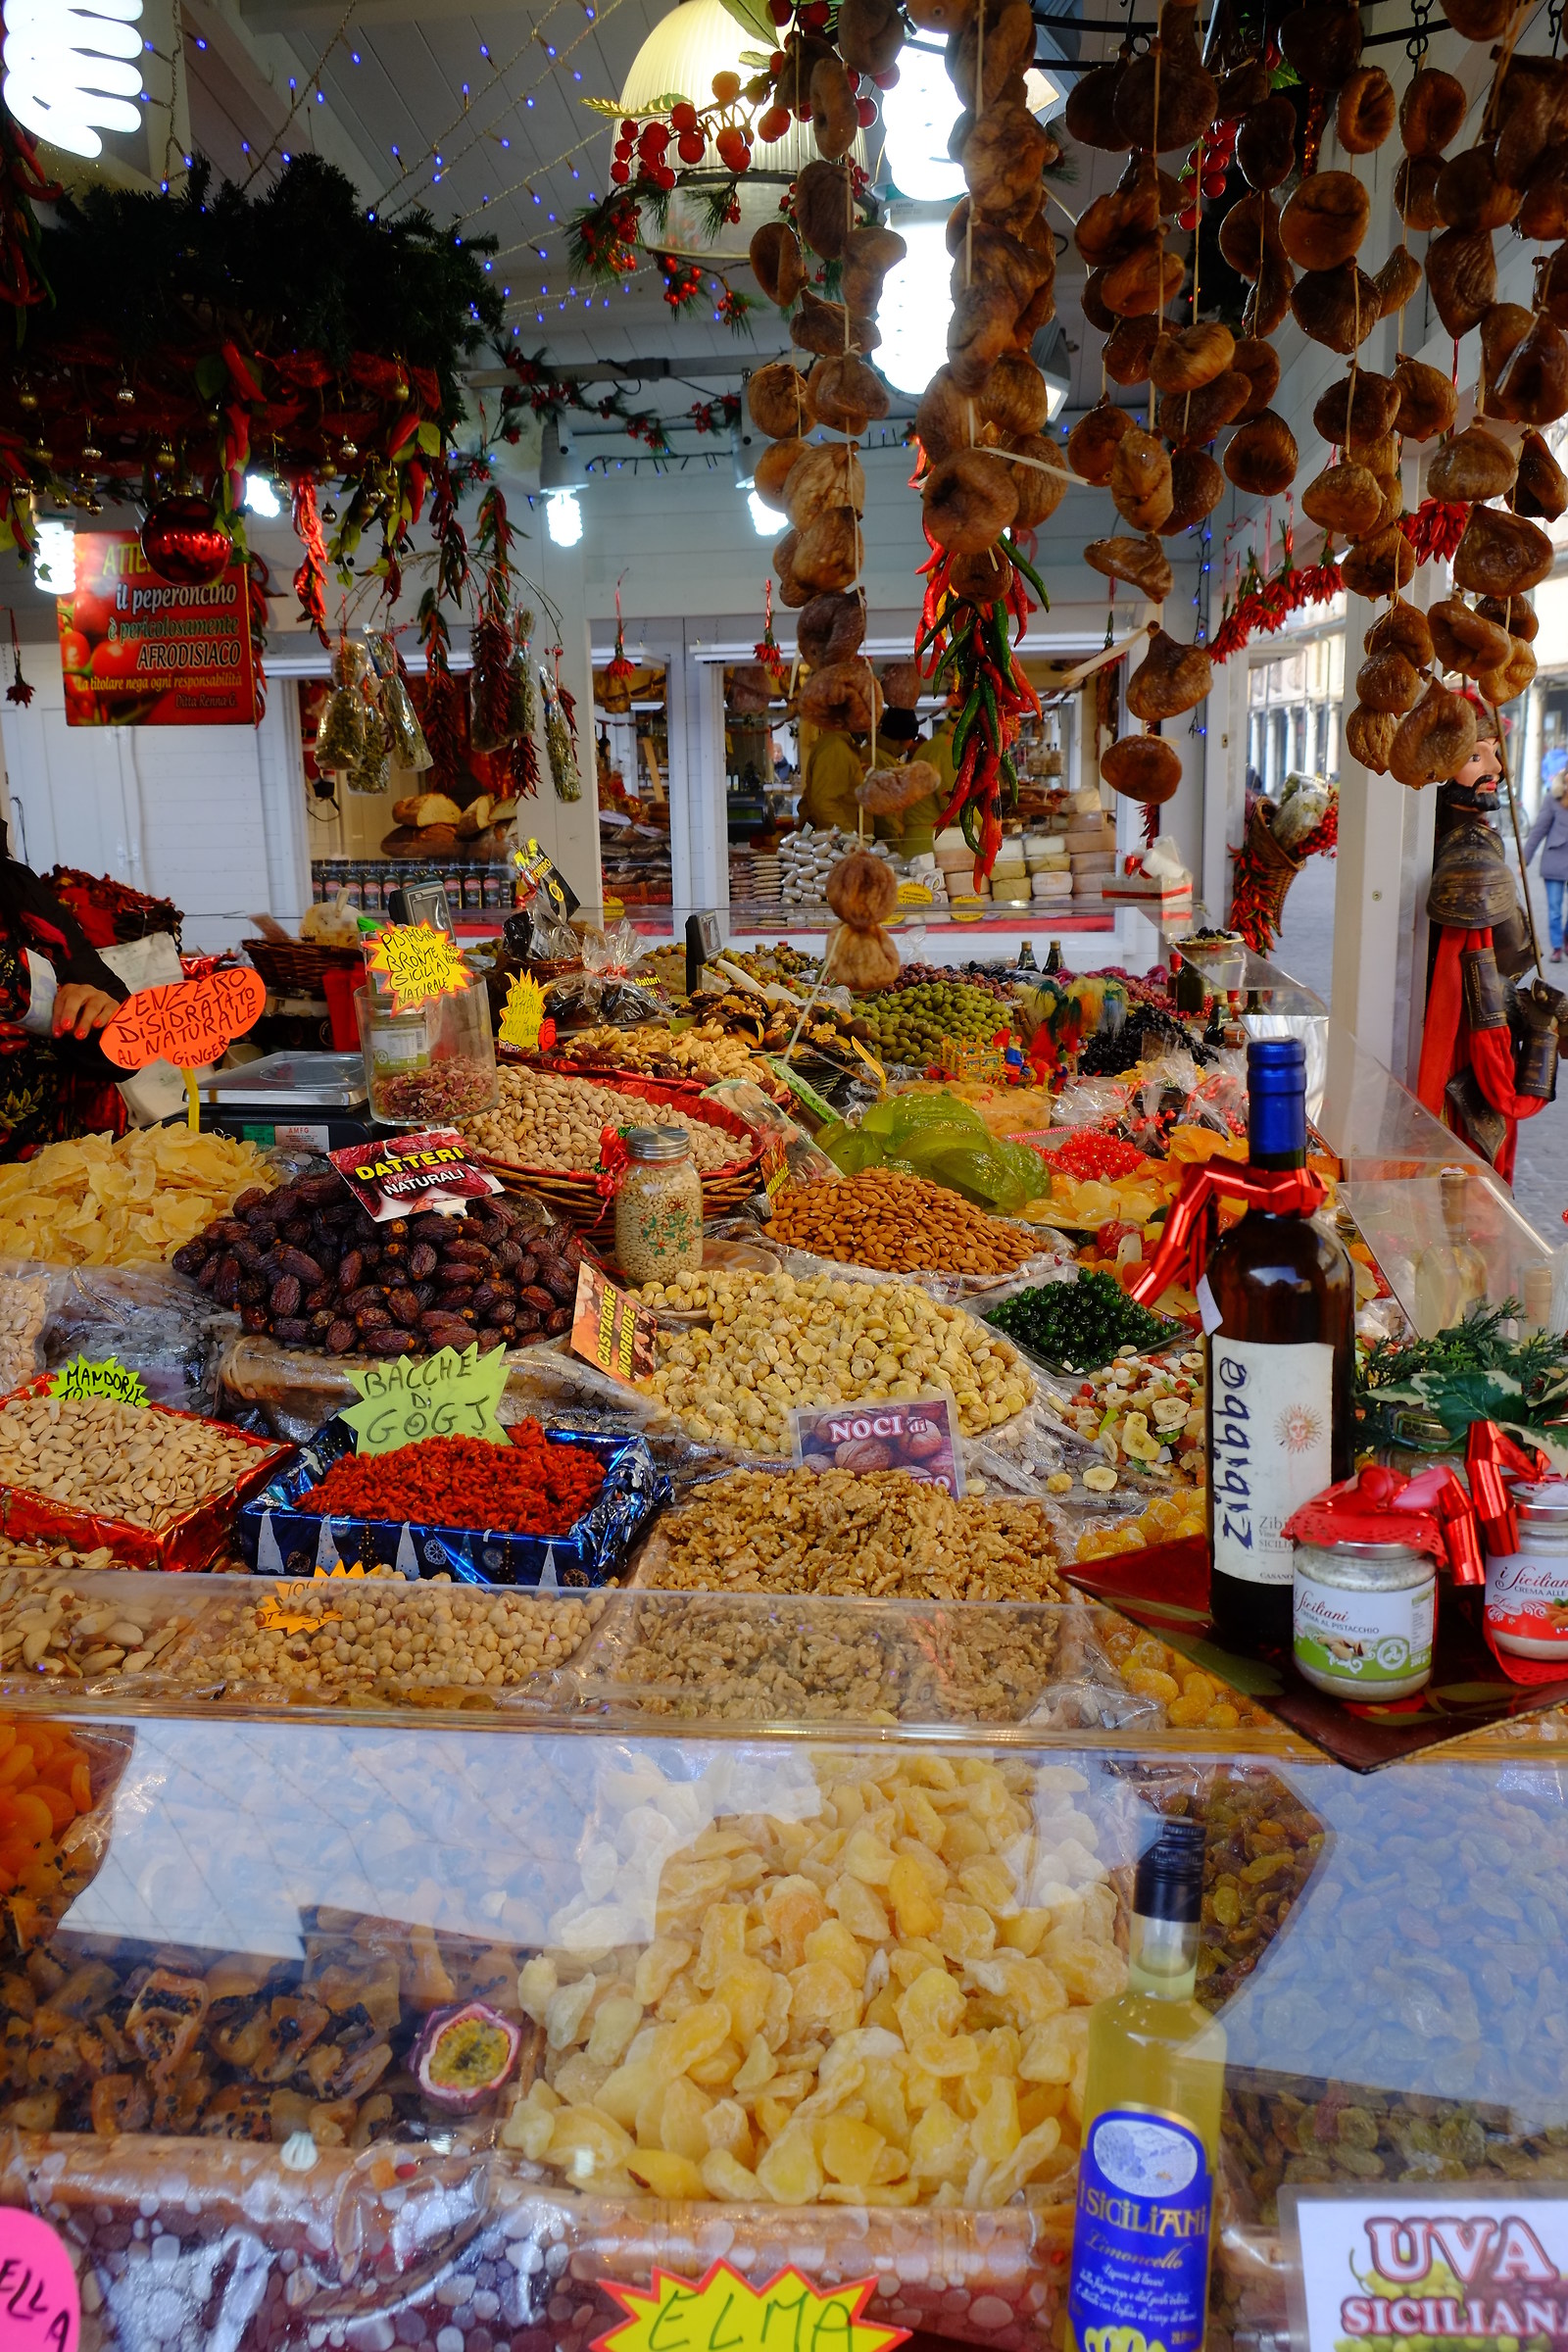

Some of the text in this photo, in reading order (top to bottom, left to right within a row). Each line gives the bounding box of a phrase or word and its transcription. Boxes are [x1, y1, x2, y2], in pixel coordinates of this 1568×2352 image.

[116, 583, 237, 614] il peperoncino
[108, 614, 239, 645] è pericolosamente
[136, 641, 241, 670] AFRODISIACO
[90, 675, 124, 690] titolare
[125, 677, 148, 693] nega
[150, 674, 172, 692] ogni
[175, 694, 197, 708] Ditta
[386, 946, 439, 972] BRONTE
[111, 969, 247, 1023] ZENZERO
[398, 977, 449, 1006] NATURALE
[635, 974, 662, 987] Datteri
[145, 1001, 257, 1055] NATURALE
[355, 1147, 466, 1181] DATTERI
[383, 1169, 466, 1196] NATURALI
[597, 1285, 617, 1367] CASTAGNE
[617, 1304, 637, 1379] MORBIDE
[67, 1365, 141, 1407] MANDORLE
[365, 1354, 471, 1398] BACCHE
[828, 1414, 927, 1444] NOCI di
[1514, 1586, 1565, 1596] CREMA ALLE
[1331, 1623, 1380, 1635] PISTACCHIO
[1085, 2228, 1193, 2270] Limoncello
[1363, 2216, 1561, 2284] UVA
[1340, 2295, 1568, 2336] SICILIAN
